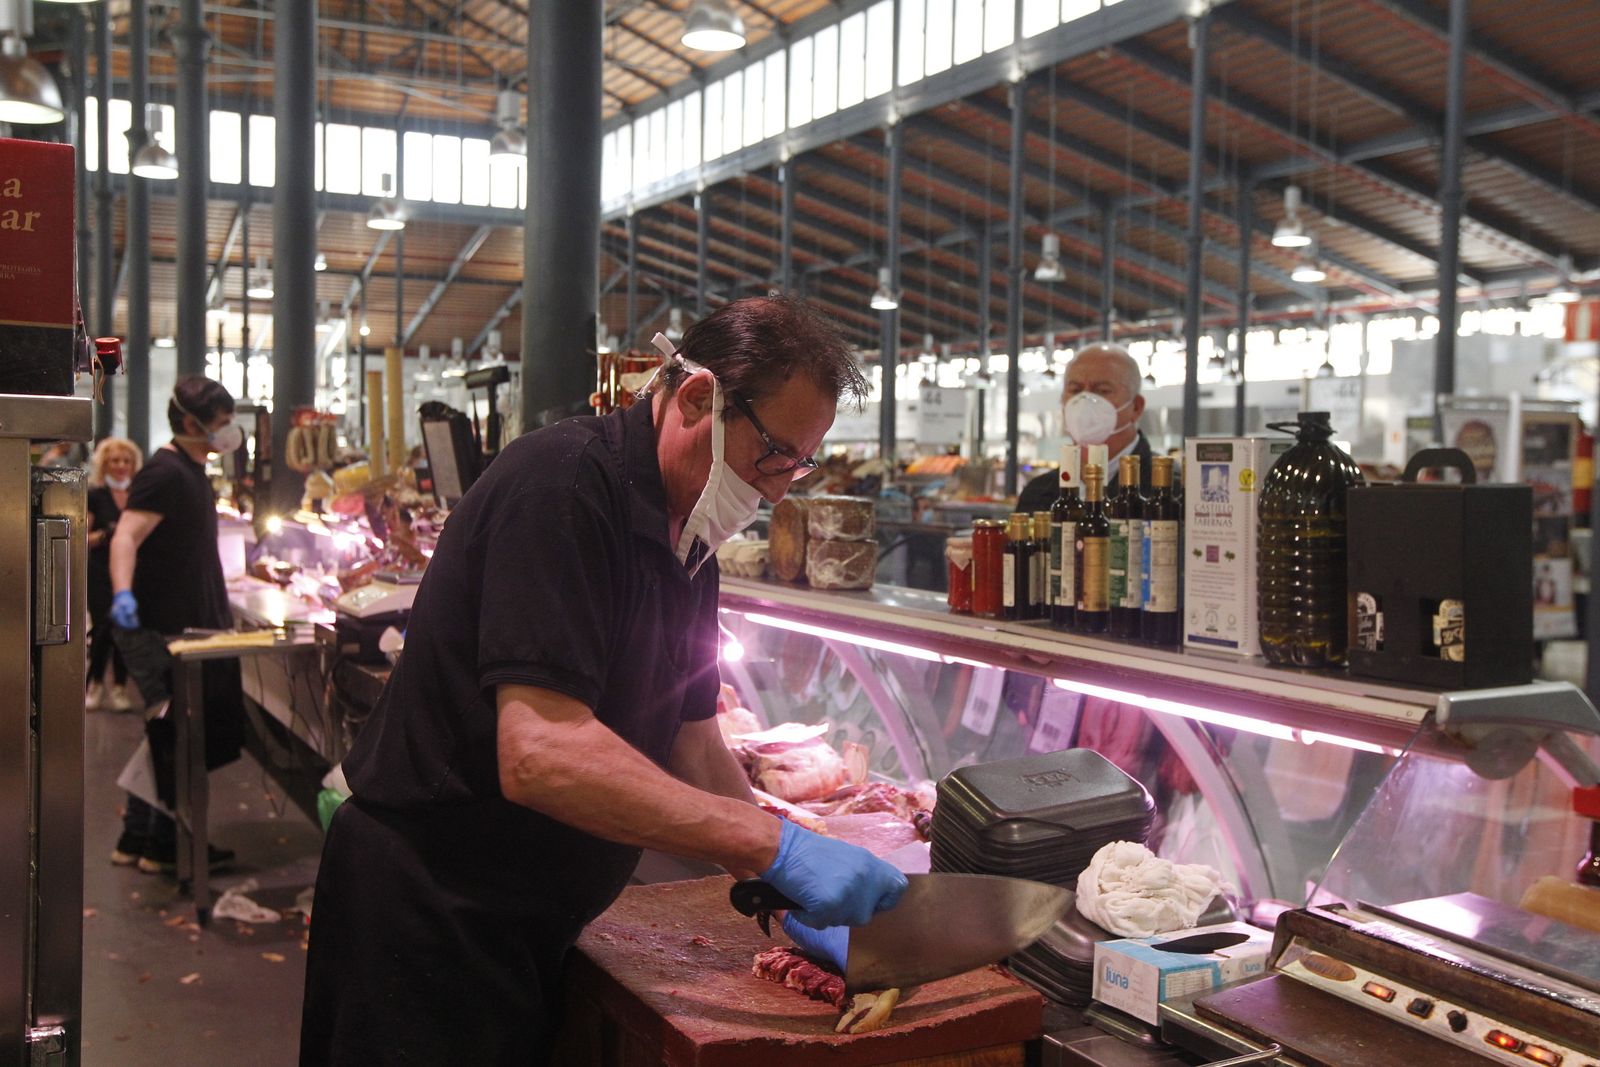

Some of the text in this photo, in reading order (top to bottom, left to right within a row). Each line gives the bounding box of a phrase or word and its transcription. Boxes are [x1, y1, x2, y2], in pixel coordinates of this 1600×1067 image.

[1194, 503, 1234, 513] CASTILLO
[1194, 517, 1233, 528] TABERNAS
[1105, 965, 1129, 990] luna
